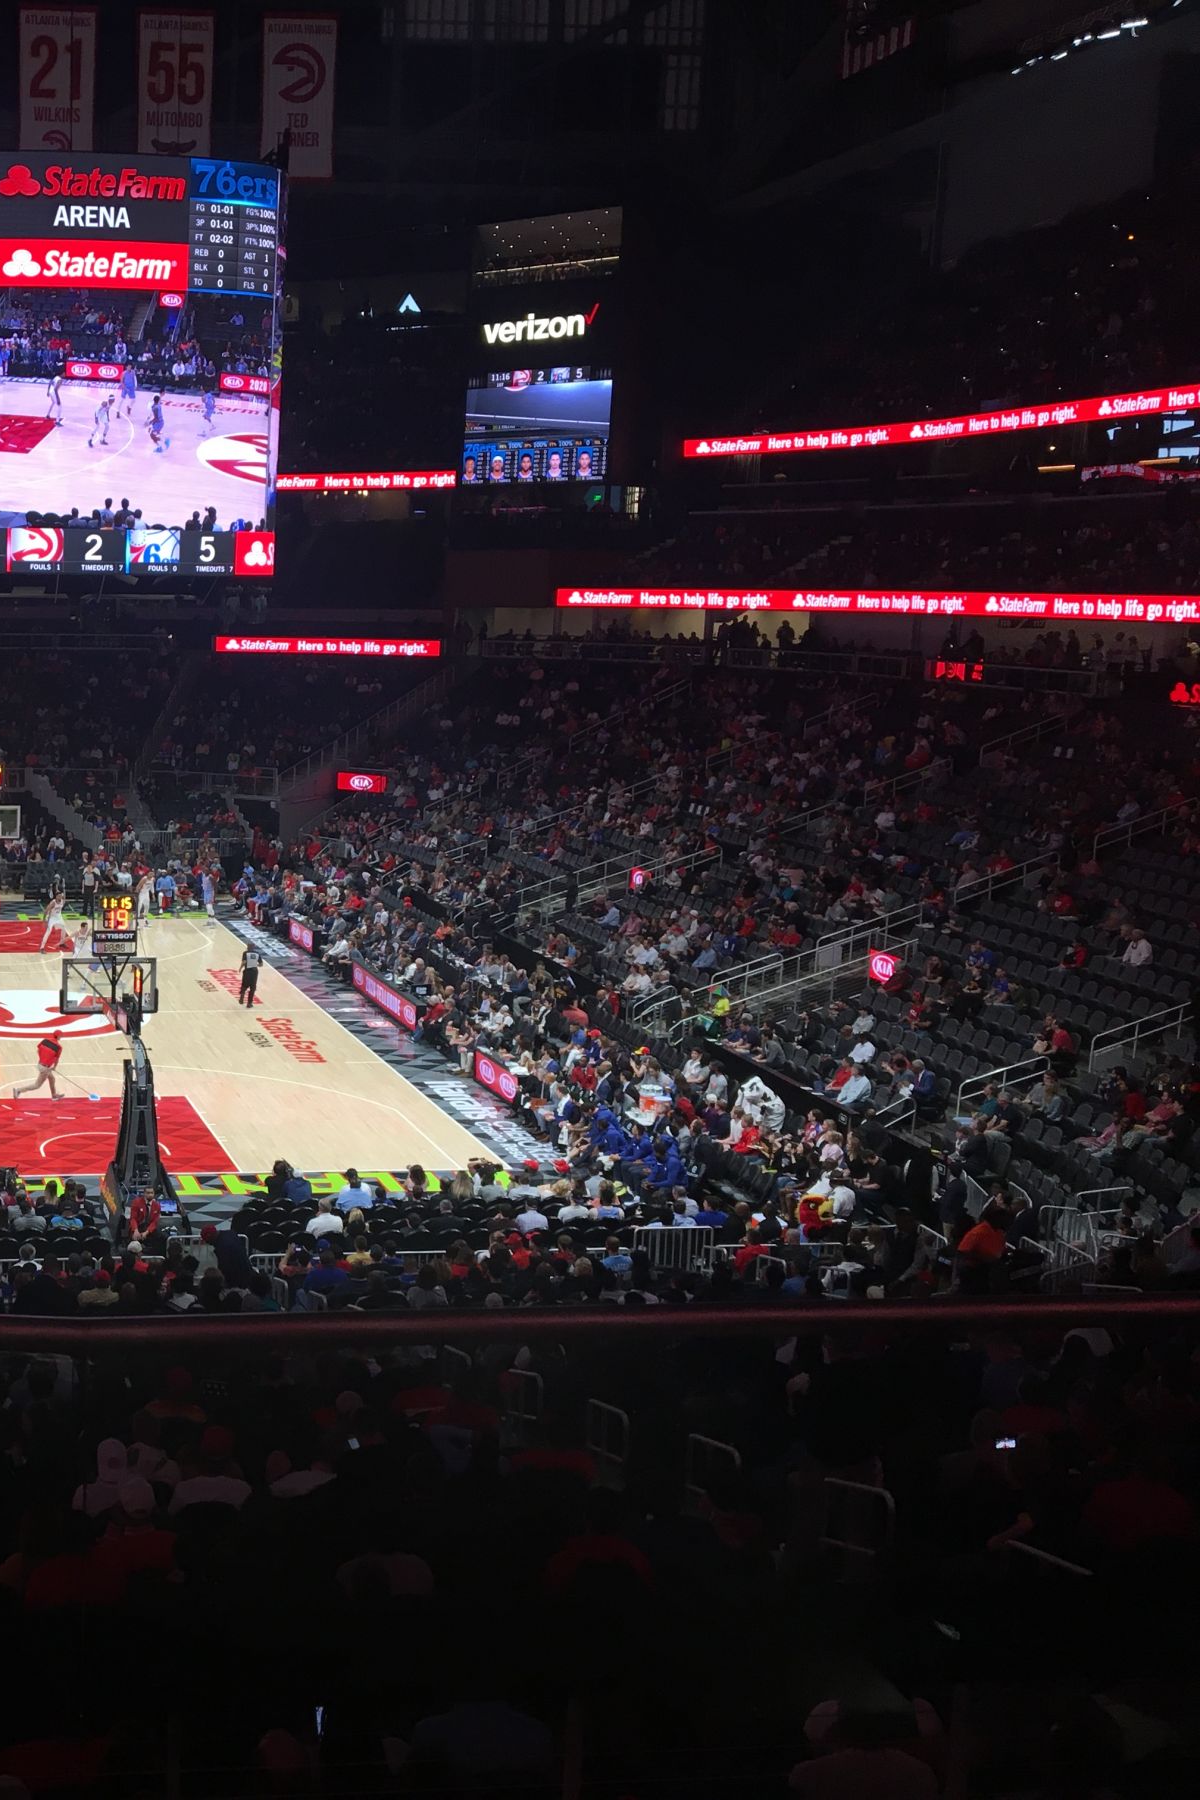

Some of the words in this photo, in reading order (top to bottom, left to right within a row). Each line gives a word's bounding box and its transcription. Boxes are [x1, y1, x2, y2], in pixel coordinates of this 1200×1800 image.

[24, 14, 60, 26] ATLANTA
[144, 19, 179, 31] ATLANTA
[180, 20, 210, 32] HAWKS
[268, 23, 303, 34] ATLANTA
[29, 35, 83, 101] 21
[146, 41, 205, 105] 55
[33, 106, 81, 124] WILKINS
[145, 111, 203, 128] MUTOMBO
[287, 112, 309, 129] TED
[194, 164, 277, 200] 76ers
[53, 205, 131, 229] ARENA
[195, 204, 205, 212] FG
[210, 205, 234, 215] 01-01
[245, 208, 259, 217] FG%
[259, 209, 275, 220] 100%
[195, 219, 205, 227] 3P
[210, 219, 234, 230] 01-01
[245, 223, 259, 232] 3P%
[259, 224, 275, 235] 100%
[195, 233, 204, 241] FT
[209, 234, 234, 245] 02-02
[245, 237, 258, 246] FT%
[258, 238, 275, 249] 100%
[194, 248, 209, 257] REB
[244, 252, 256, 261] AST
[194, 263, 208, 272] BLK
[243, 266, 256, 275] STL
[194, 278, 203, 286] TO
[243, 281, 255, 290] FLS
[483, 313, 586, 344] verizon
[491, 373, 511, 382] 11:16
[537, 371, 544, 381] 2
[575, 368, 583, 378] 5
[768, 438, 791, 449] Here
[794, 437, 804, 447] to
[807, 434, 828, 448] help
[832, 432, 847, 444] life
[851, 434, 862, 446] go
[84, 533, 103, 561] 2
[199, 536, 216, 562] 5
[640, 592, 666, 604] Here
[670, 594, 680, 605] to
[684, 593, 704, 607] help
[708, 593, 723, 605] life
[727, 596, 739, 608] go
[298, 641, 323, 651] Here
[326, 642, 336, 651] to
[340, 641, 360, 653] help
[364, 642, 380, 652] life
[384, 645, 396, 654] go
[103, 896, 132, 909] 11:15
[110, 909, 129, 930] 19
